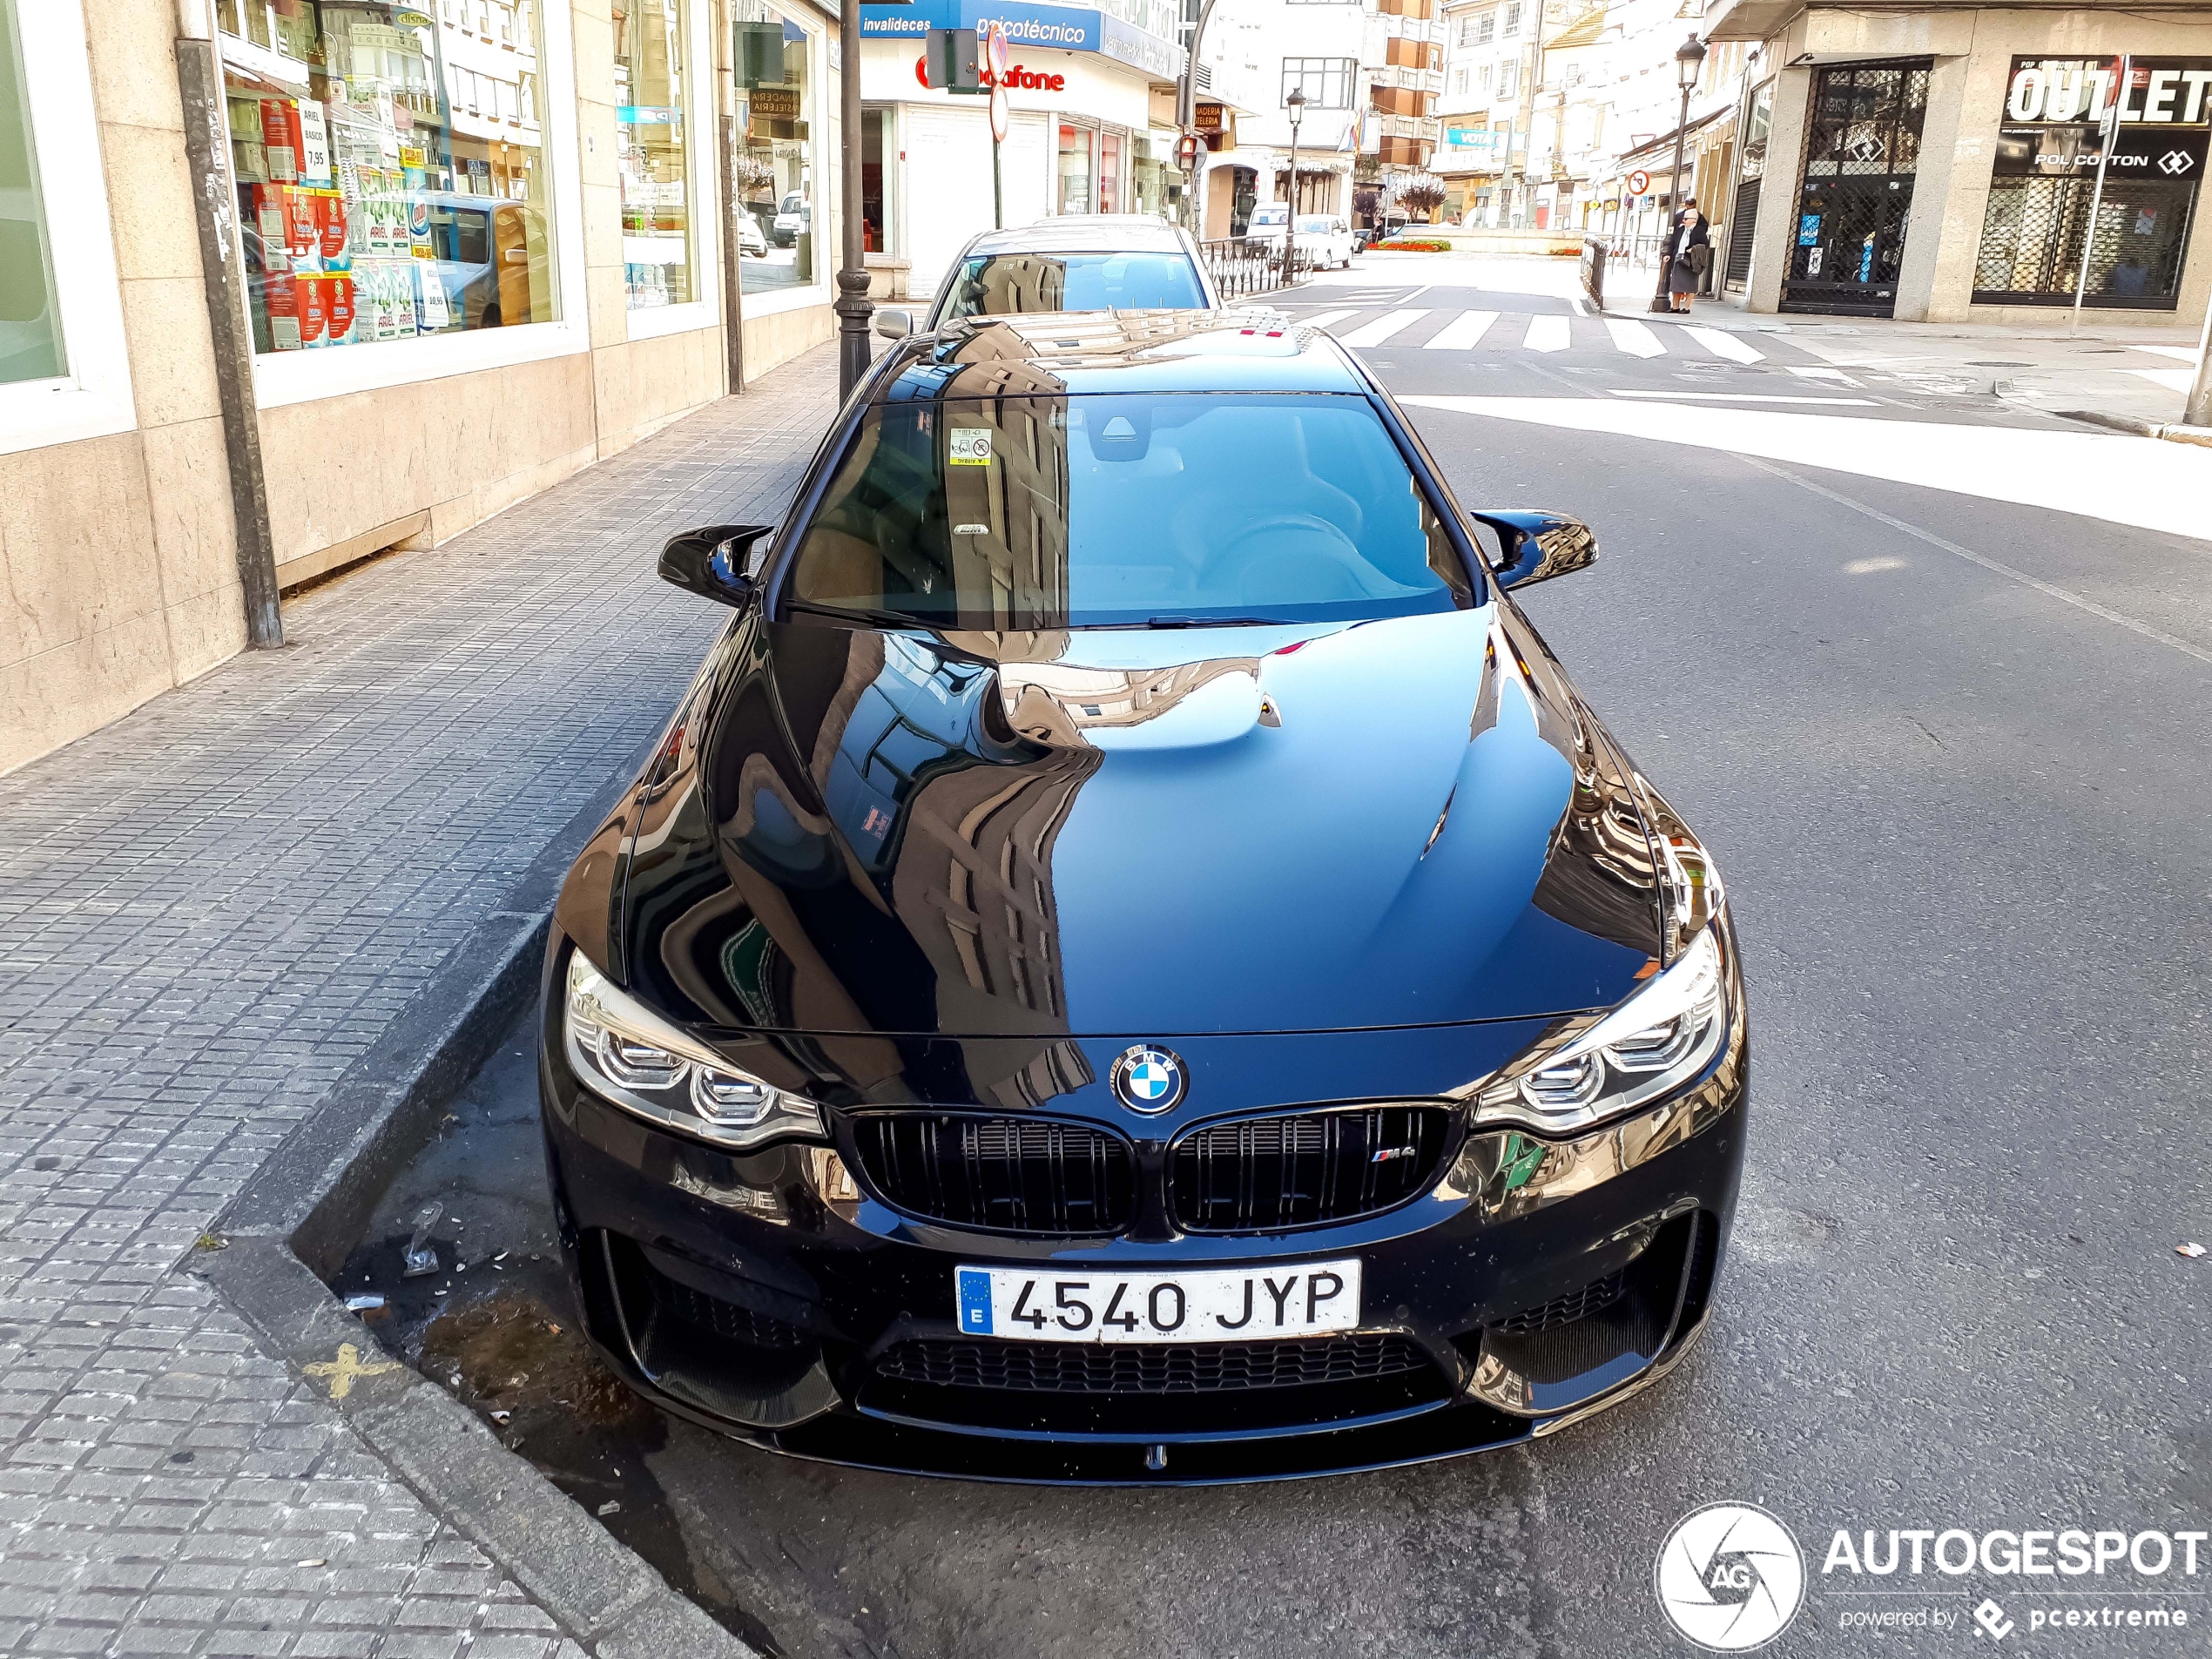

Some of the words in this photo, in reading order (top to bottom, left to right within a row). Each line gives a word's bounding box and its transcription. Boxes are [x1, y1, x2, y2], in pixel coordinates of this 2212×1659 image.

[863, 17, 931, 32] invalideces
[980, 65, 1064, 91] afone
[2008, 68, 2212, 123] OUTLET
[304, 110, 320, 122] ARIEL
[1196, 106, 1220, 116] NADERIA
[305, 130, 322, 140] BASICO
[308, 151, 324, 166] 7,95
[2034, 154, 2069, 165] POL
[2074, 154, 2148, 166] COTON
[370, 226, 388, 239] ARIEL
[393, 227, 408, 239] ARIEL
[429, 296, 443, 307] 10,95
[378, 315, 395, 327] ARIEL
[399, 314, 415, 326] ARIEL
[1124, 1053, 1176, 1072] BMW
[970, 1309, 983, 1325] E
[1010, 1279, 1186, 1332] 4540
[1215, 1271, 1345, 1330] JYP
